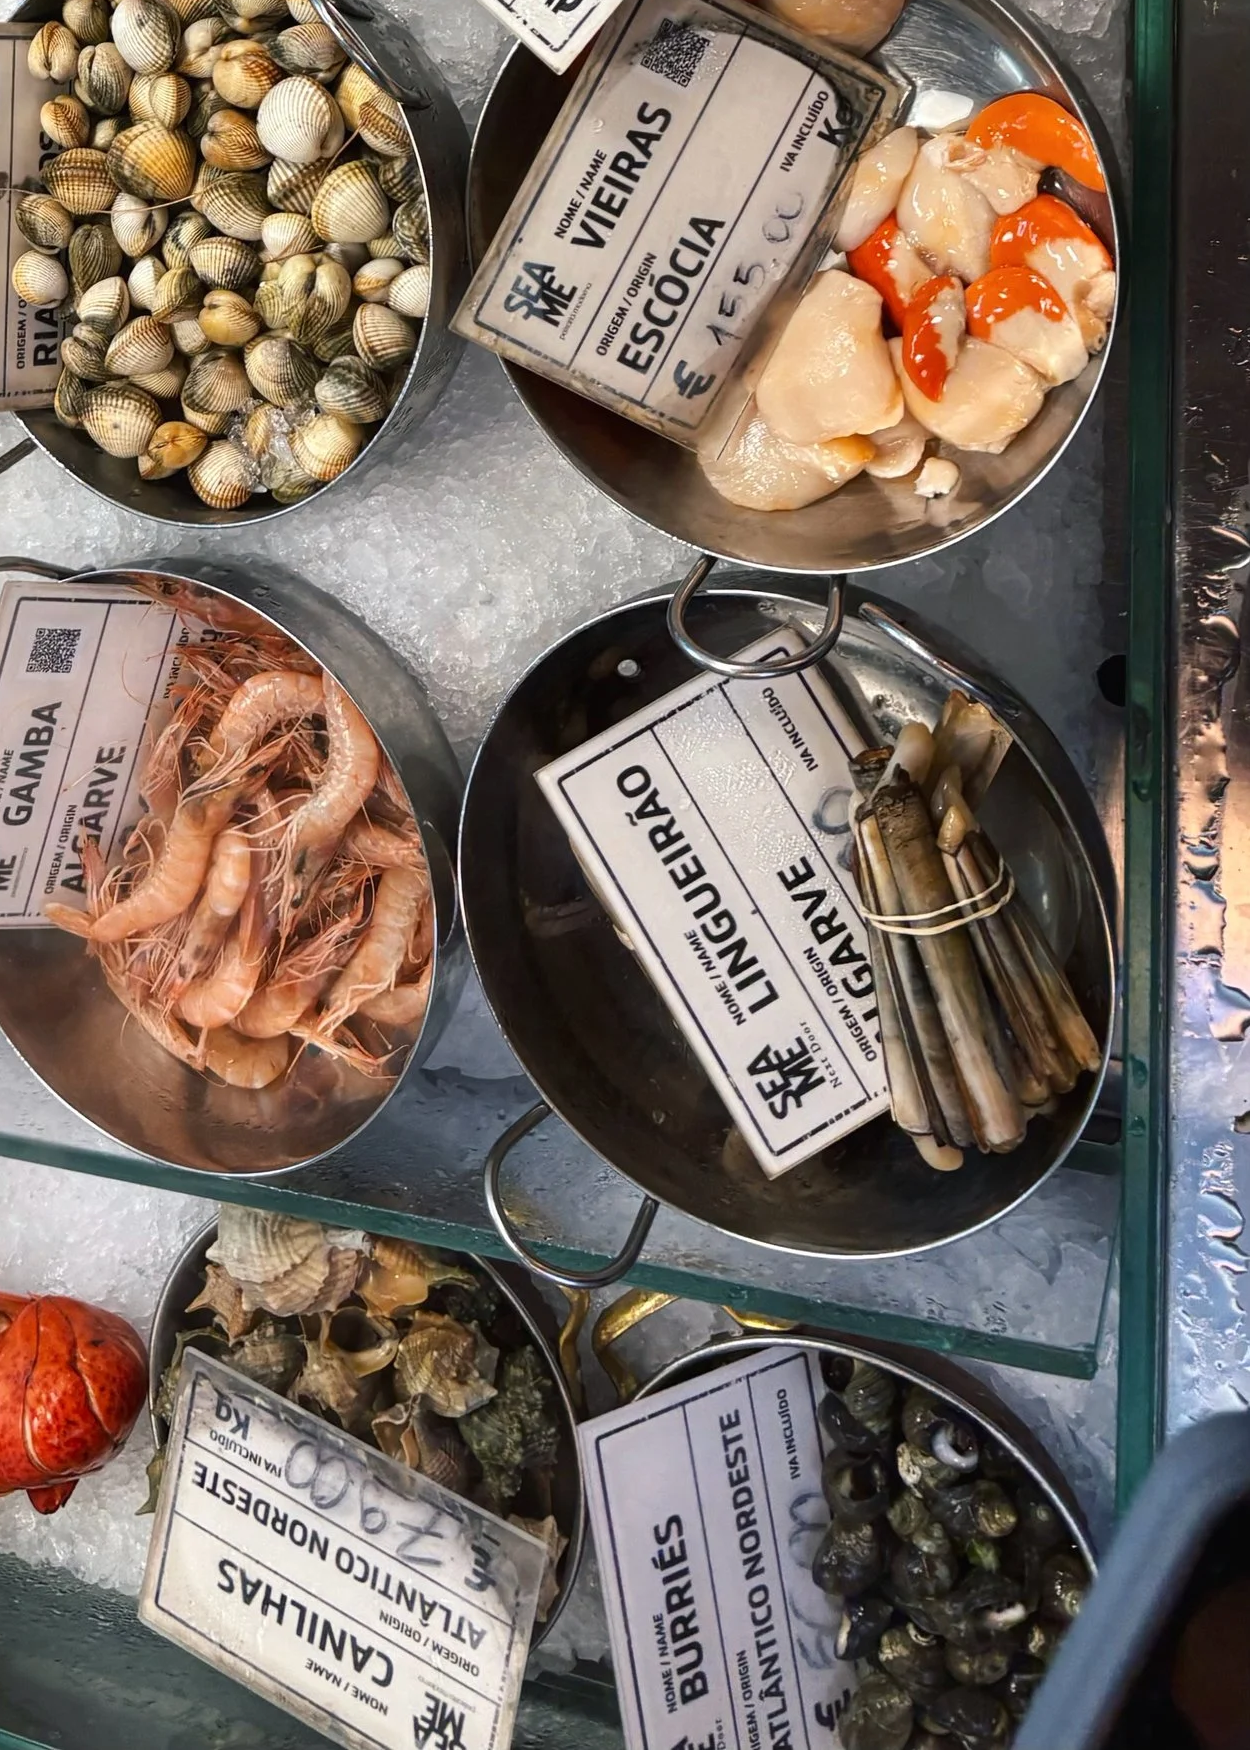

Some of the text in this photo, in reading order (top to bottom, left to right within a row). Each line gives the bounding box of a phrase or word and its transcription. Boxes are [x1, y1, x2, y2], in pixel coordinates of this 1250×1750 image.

[570, 101, 672, 249] VIEIRAS
[780, 90, 829, 172] IVA INCLUÍDO
[554, 149, 607, 239] NOME NAME
[503, 262, 556, 320] SEA
[528, 273, 578, 327] ME
[596, 252, 657, 356] ORIGEM ORIGIN
[616, 217, 726, 375] ESCÓCIA
[16, 319, 27, 370] ORIGEM
[672, 359, 716, 399] €
[2, 701, 62, 826] GAMBA
[762, 687, 819, 772] IVA INCLUÍDO
[44, 805, 78, 895] ORIGEM ORIGIN
[616, 765, 779, 1014] LINGUEIRÃO
[684, 930, 747, 1026] NOME NAME
[803, 946, 877, 1062] ORIGEM ORIGIN
[746, 1044, 803, 1120] SEA
[770, 1037, 826, 1100] ME
[209, 1424, 282, 1478] IVA INCLUÍDO
[776, 1388, 801, 1480] IVA INCLUÍDO
[192, 1461, 486, 1650] ATLÂNTICO NORDESTE
[719, 1409, 794, 1750] ATLÂNTICO NORDESTE
[217, 1558, 394, 1688] CANILHAS
[379, 1610, 480, 1677] ORIGEM ORIGIN
[651, 1514, 709, 1706] BURRIÉS
[305, 1658, 342, 1687] NAME
[351, 1685, 388, 1716] NOME
[652, 1613, 678, 1714] NOME NAME
[736, 1650, 753, 1702] ORIGIN
